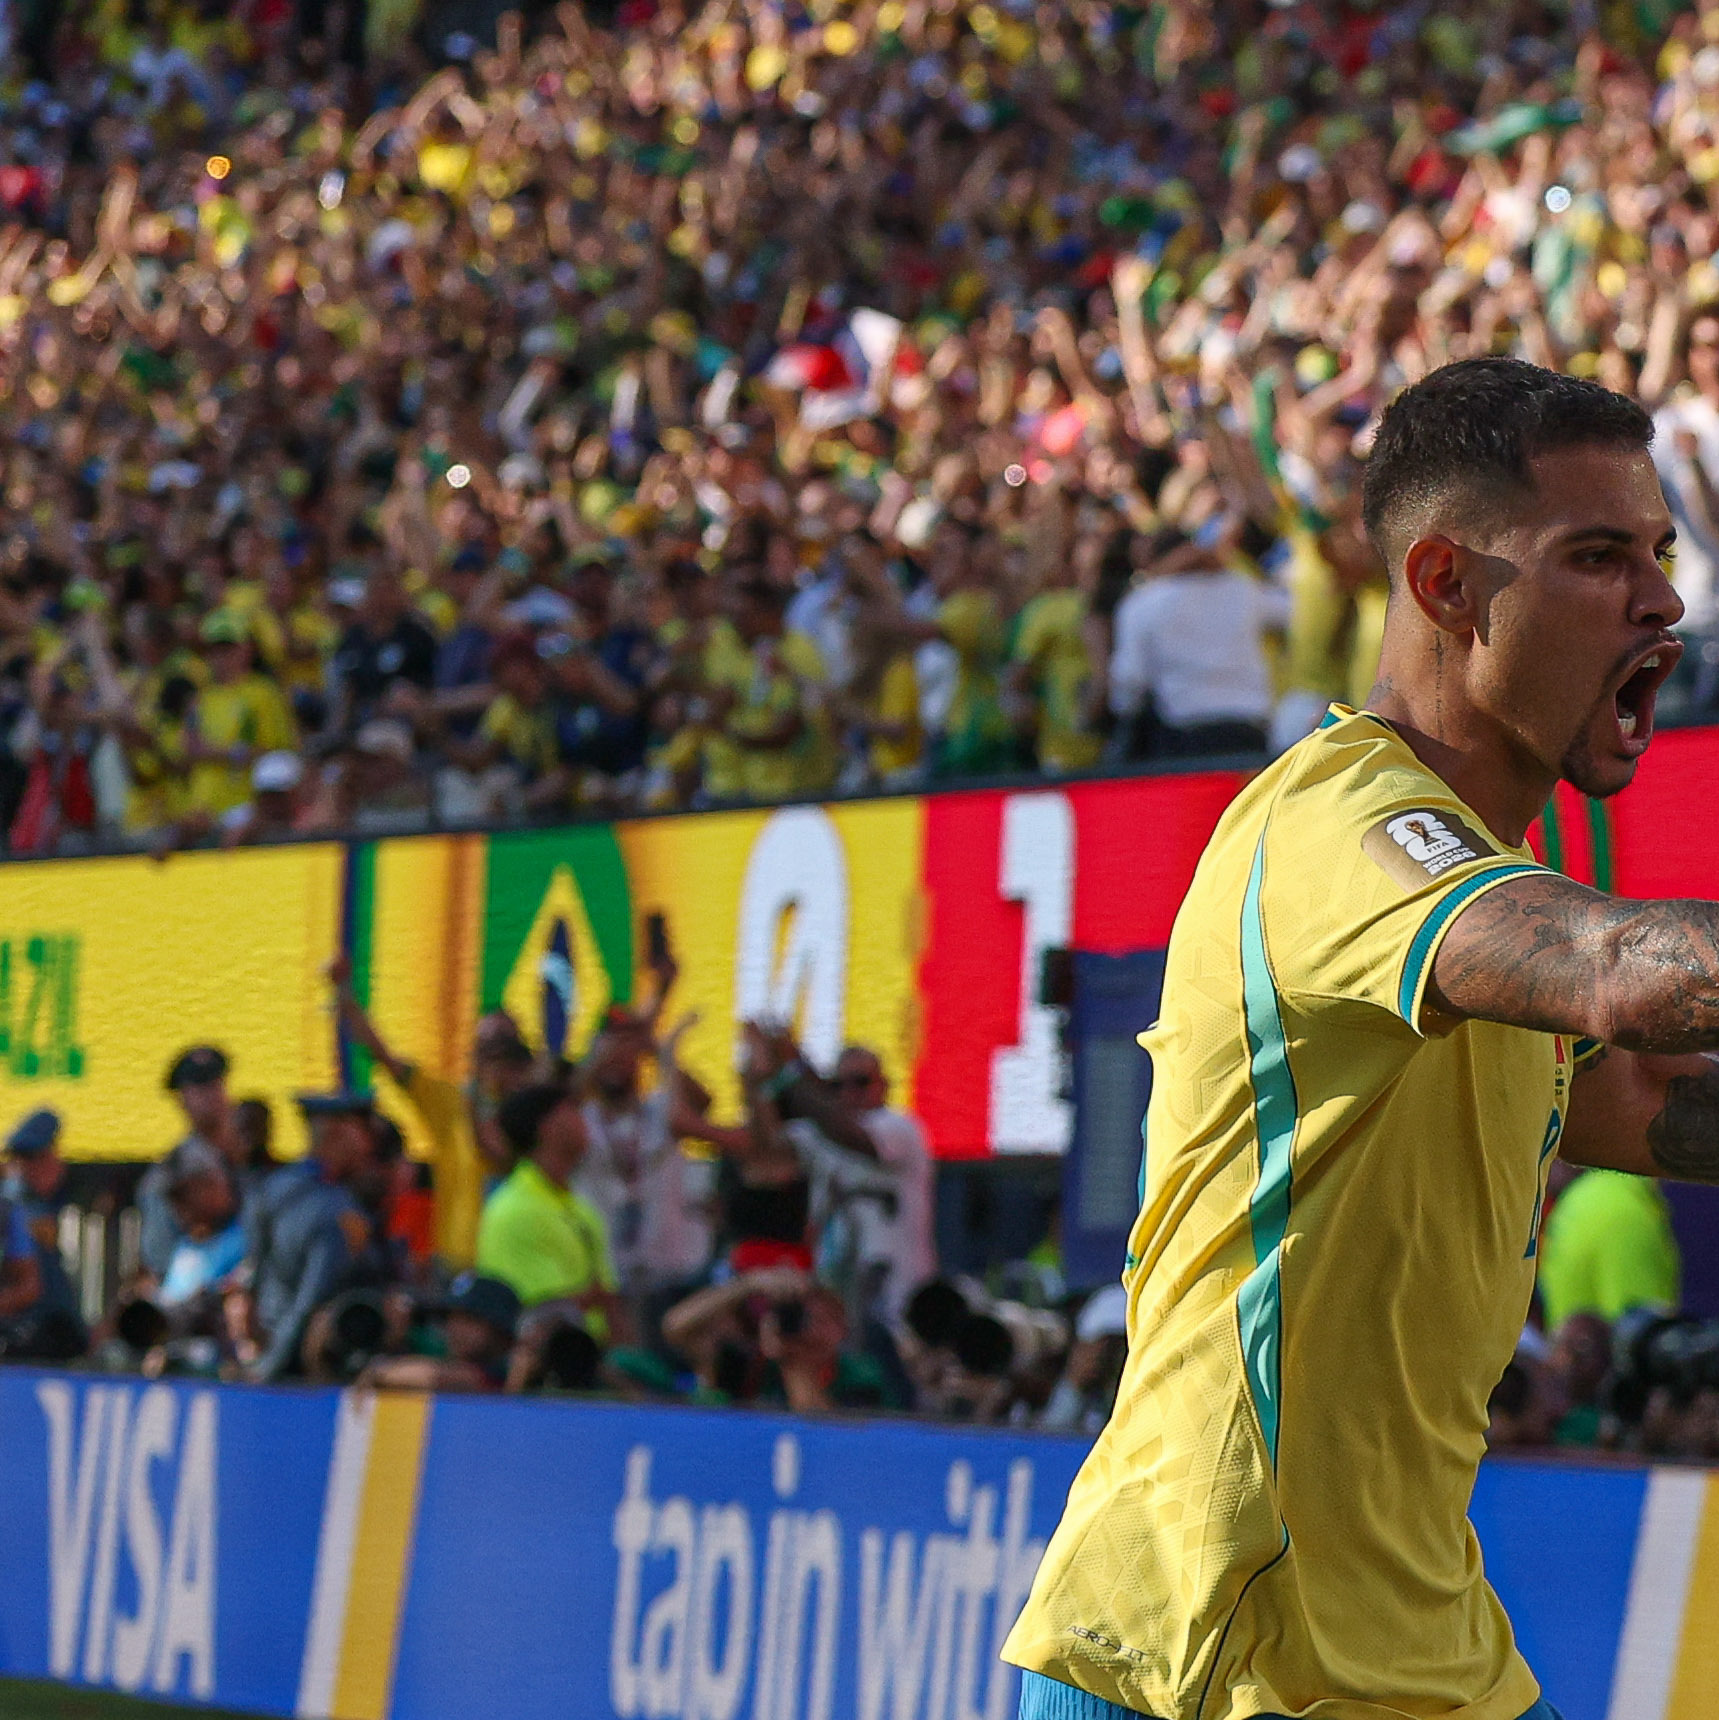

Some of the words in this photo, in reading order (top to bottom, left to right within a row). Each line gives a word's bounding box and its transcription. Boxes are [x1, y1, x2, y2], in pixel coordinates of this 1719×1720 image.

[1427, 842, 1449, 853] FIFA
[1428, 851, 1477, 876] 2026
[985, 790, 1077, 1156] 1
[35, 1379, 218, 1697] VISA
